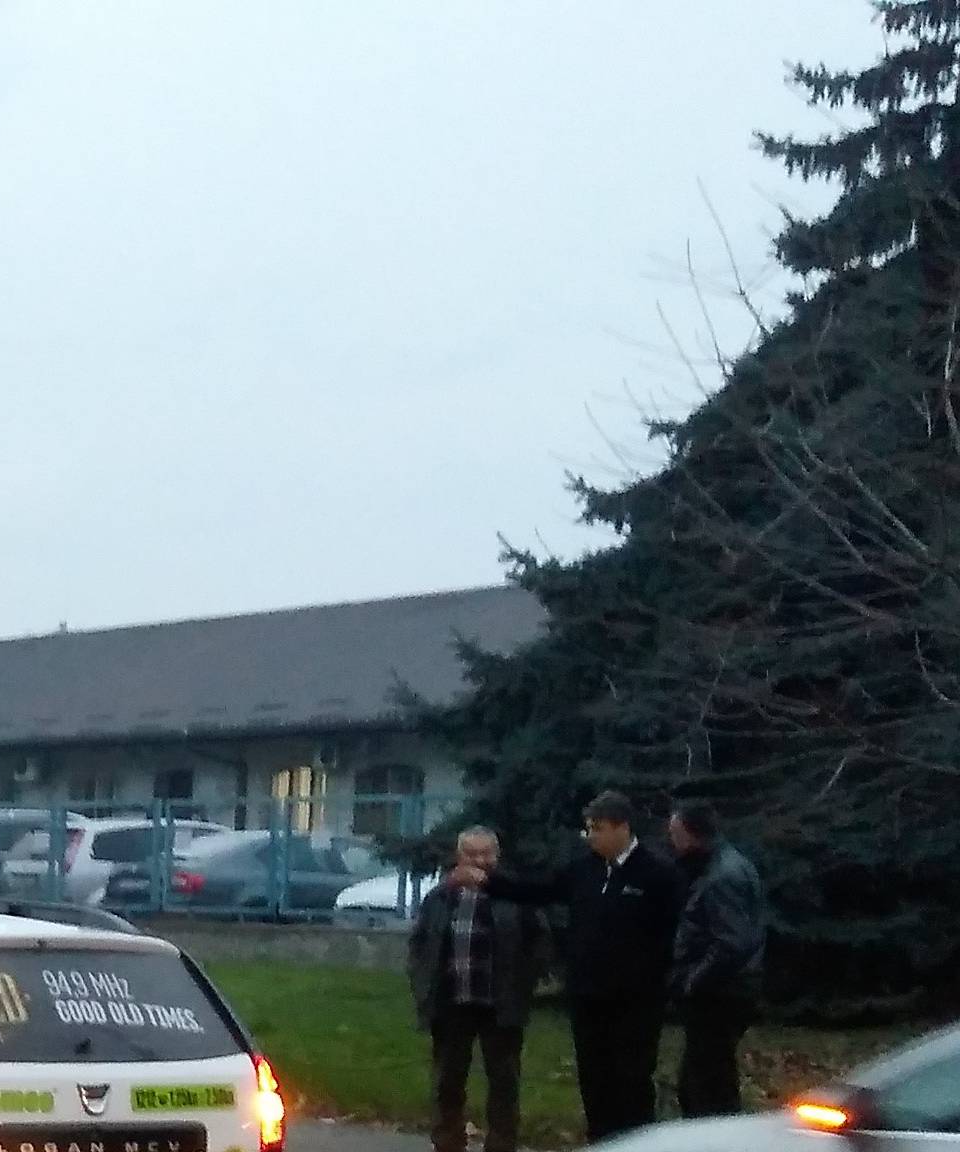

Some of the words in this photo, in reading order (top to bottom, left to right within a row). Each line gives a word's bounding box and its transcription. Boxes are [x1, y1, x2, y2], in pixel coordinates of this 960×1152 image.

[89, 971, 133, 1000] MHz
[55, 999, 108, 1024] GOOD
[108, 1001, 144, 1026] OLD
[125, 1140, 181, 1152] MCV
